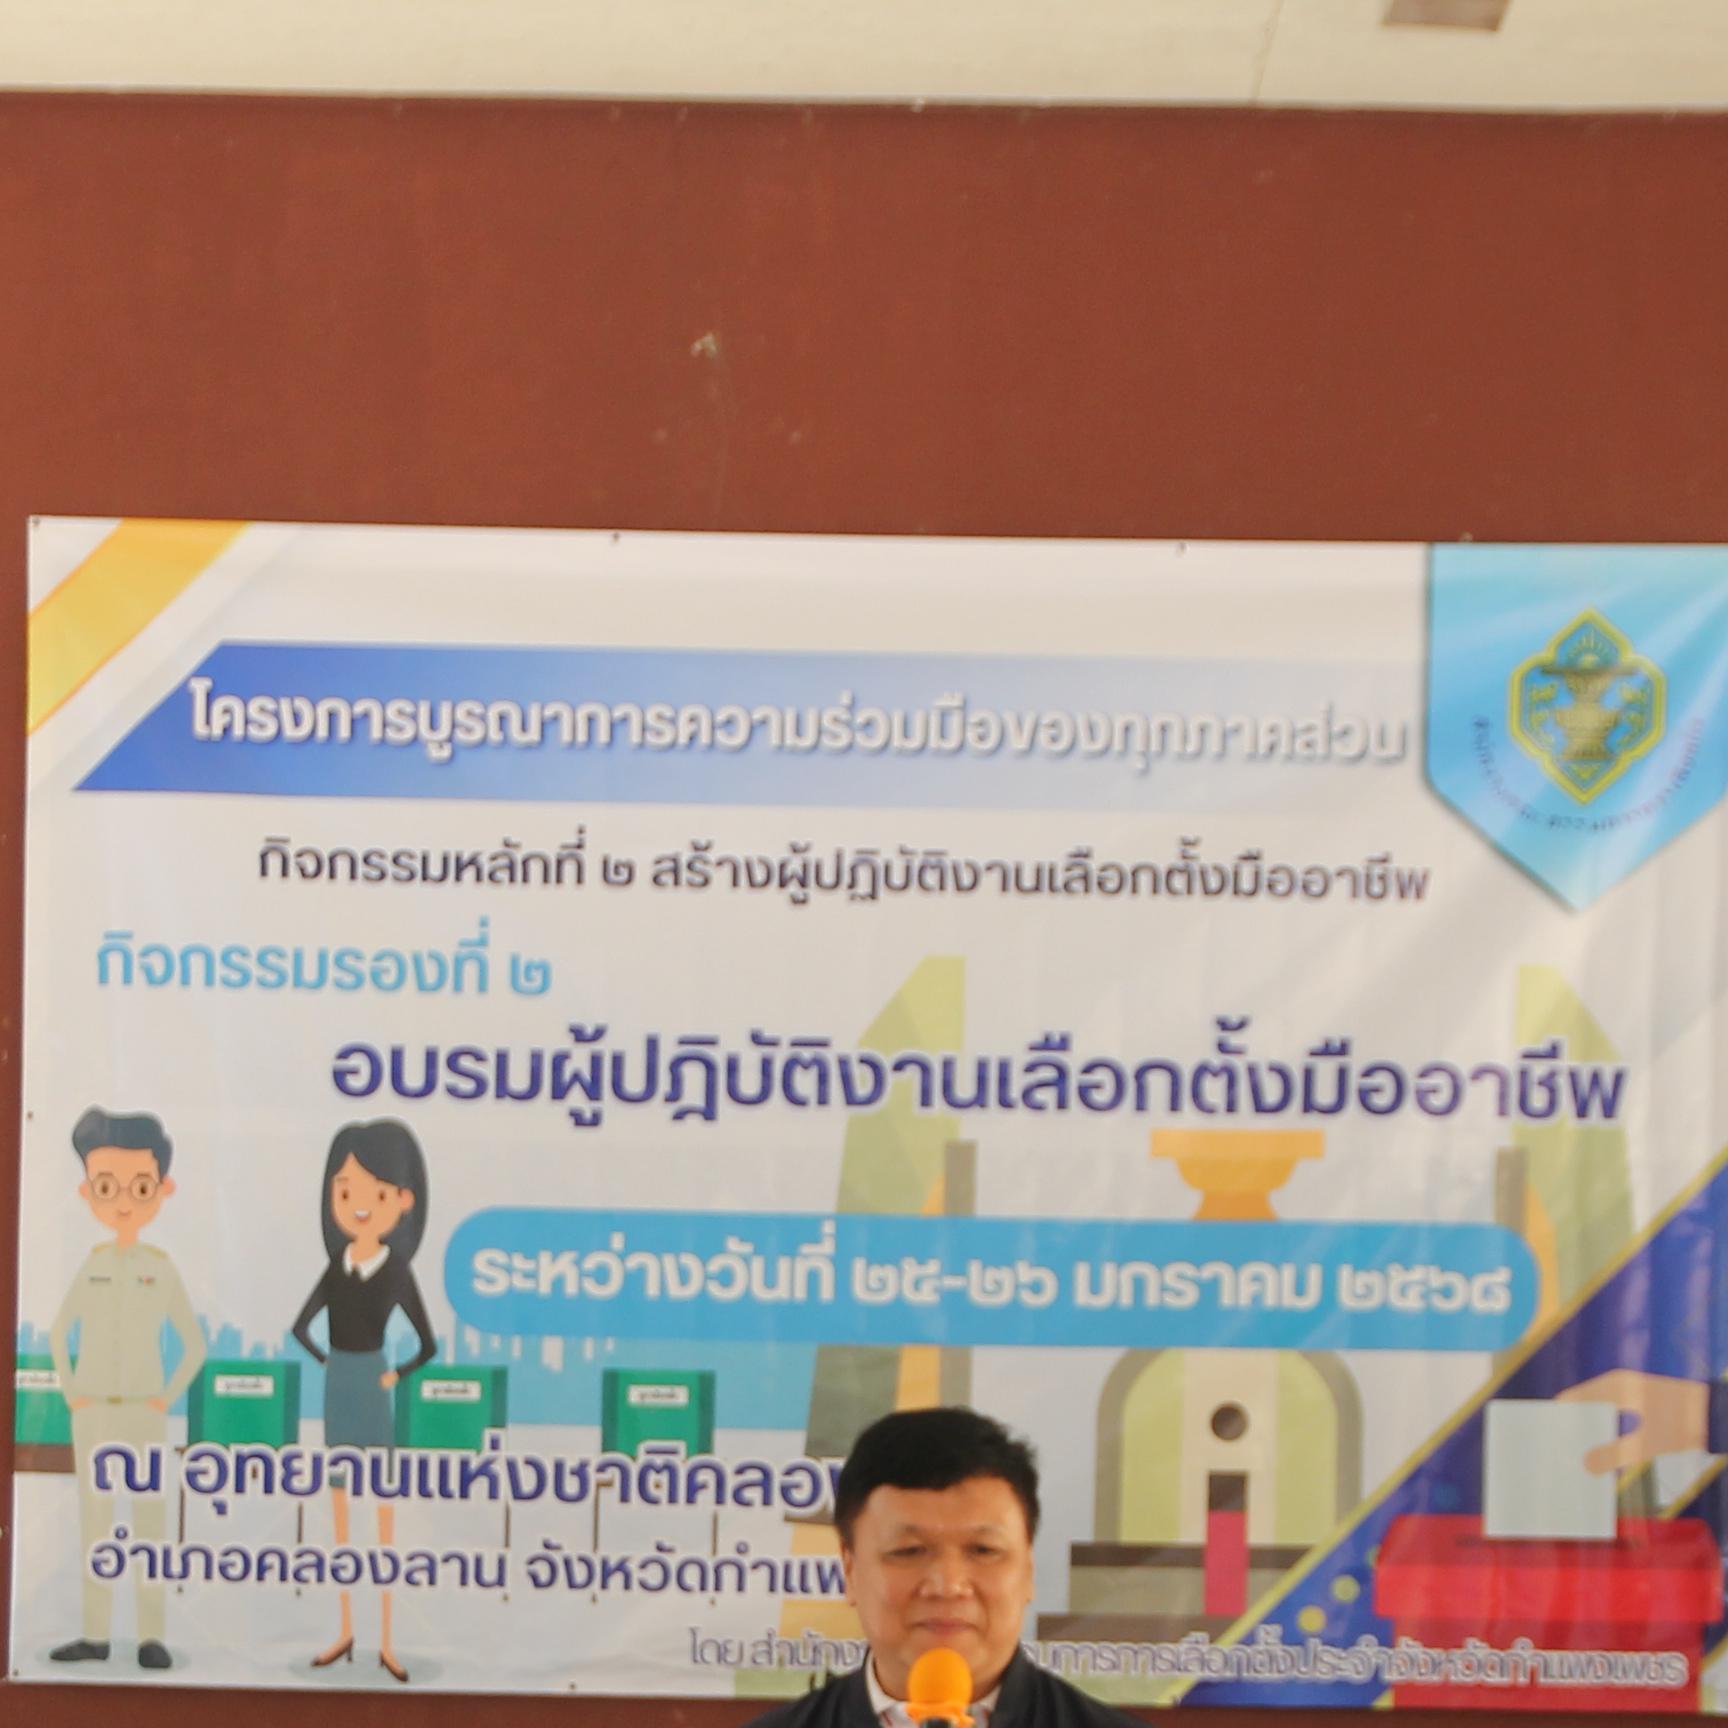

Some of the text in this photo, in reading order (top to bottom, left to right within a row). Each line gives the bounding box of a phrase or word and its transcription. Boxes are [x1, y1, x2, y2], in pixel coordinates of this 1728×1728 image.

[187, 675, 1412, 774] โครงการบูรณาการความร่วมมือของทุกภาคส่วน
[258, 824, 1432, 906] กิจกรรมหลักที่ ๒ สร้างผู้ปฏิบัติงานเลือกตั้งมืออาชีพ
[95, 916, 554, 996] กิจกรรมรองที่ ๒
[330, 1014, 1628, 1128] อบรมผู้ปฏิบัติงานเลือกตั้งมืออาชีพ
[471, 1219, 837, 1302] ระหว่างวันที่
[1072, 1258, 1322, 1311] มกราคม
[92, 1443, 162, 1494] ณ
[90, 1526, 507, 1592] อำเภอคลองลาน
